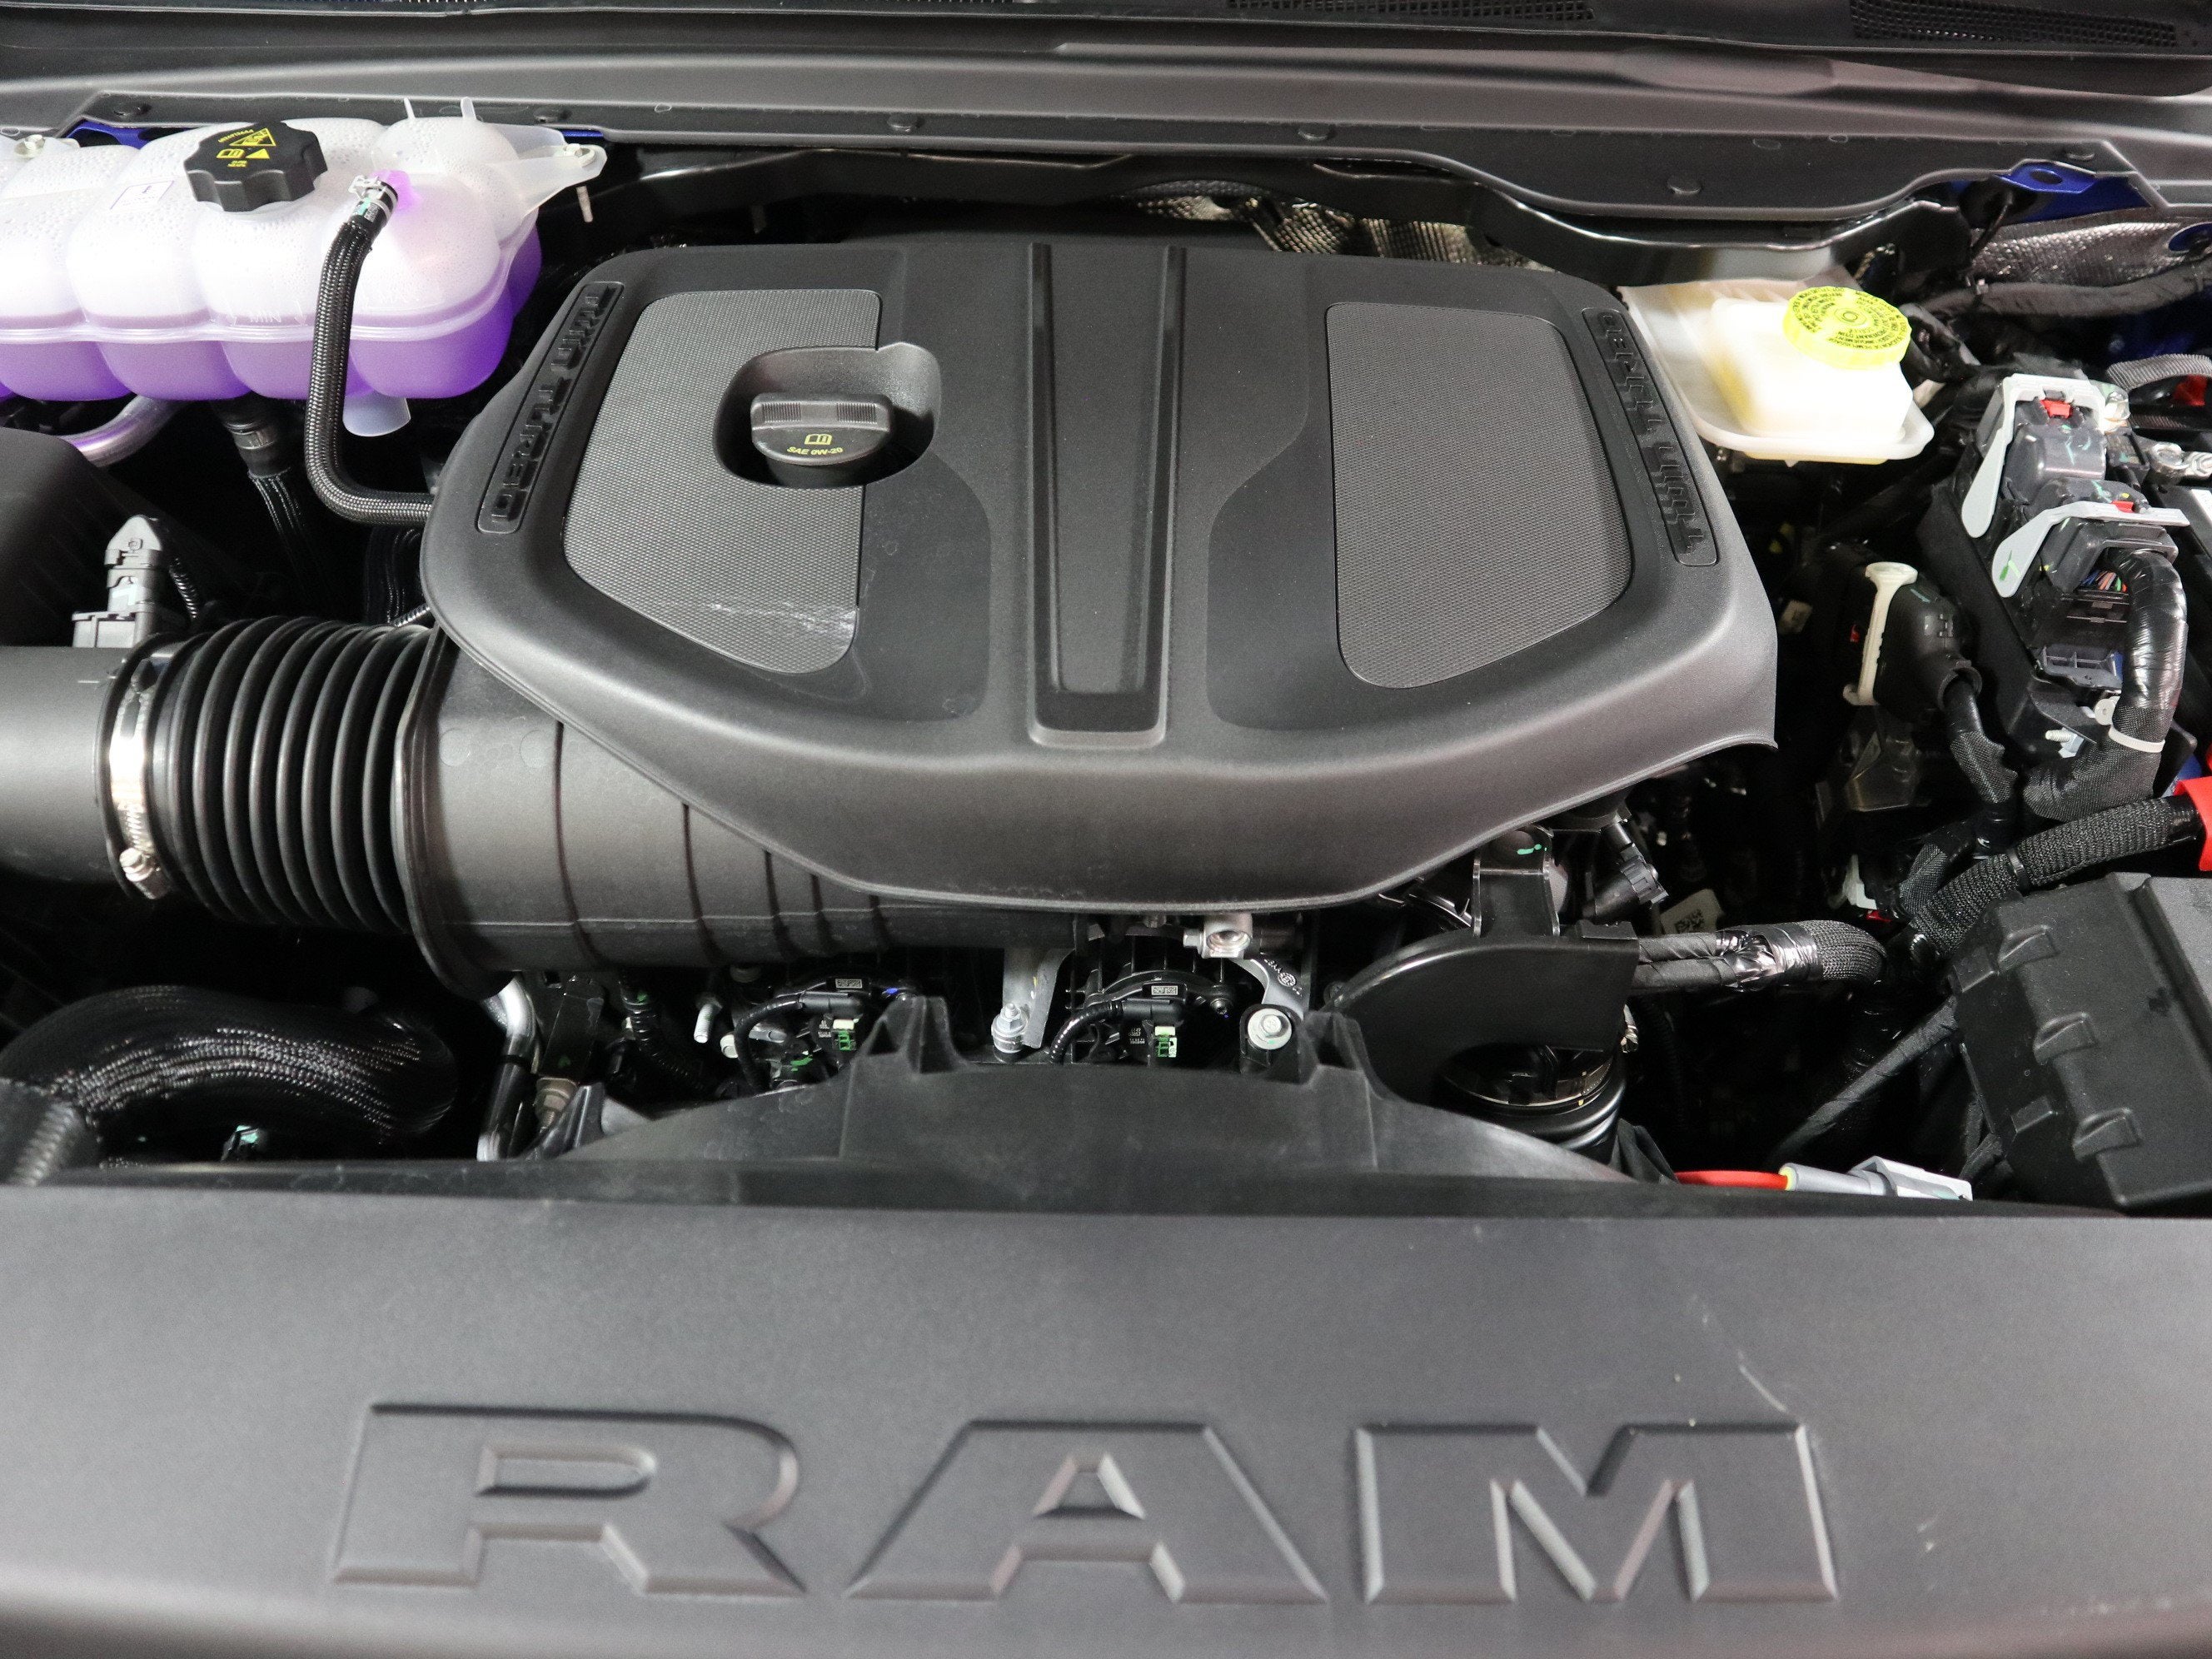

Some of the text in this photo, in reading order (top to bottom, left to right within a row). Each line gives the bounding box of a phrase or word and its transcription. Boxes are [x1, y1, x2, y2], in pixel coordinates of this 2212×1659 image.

[491, 379, 567, 523] TURBO
[786, 446, 844, 456] SAE 0W-20
[331, 1401, 1841, 1604] RAM
